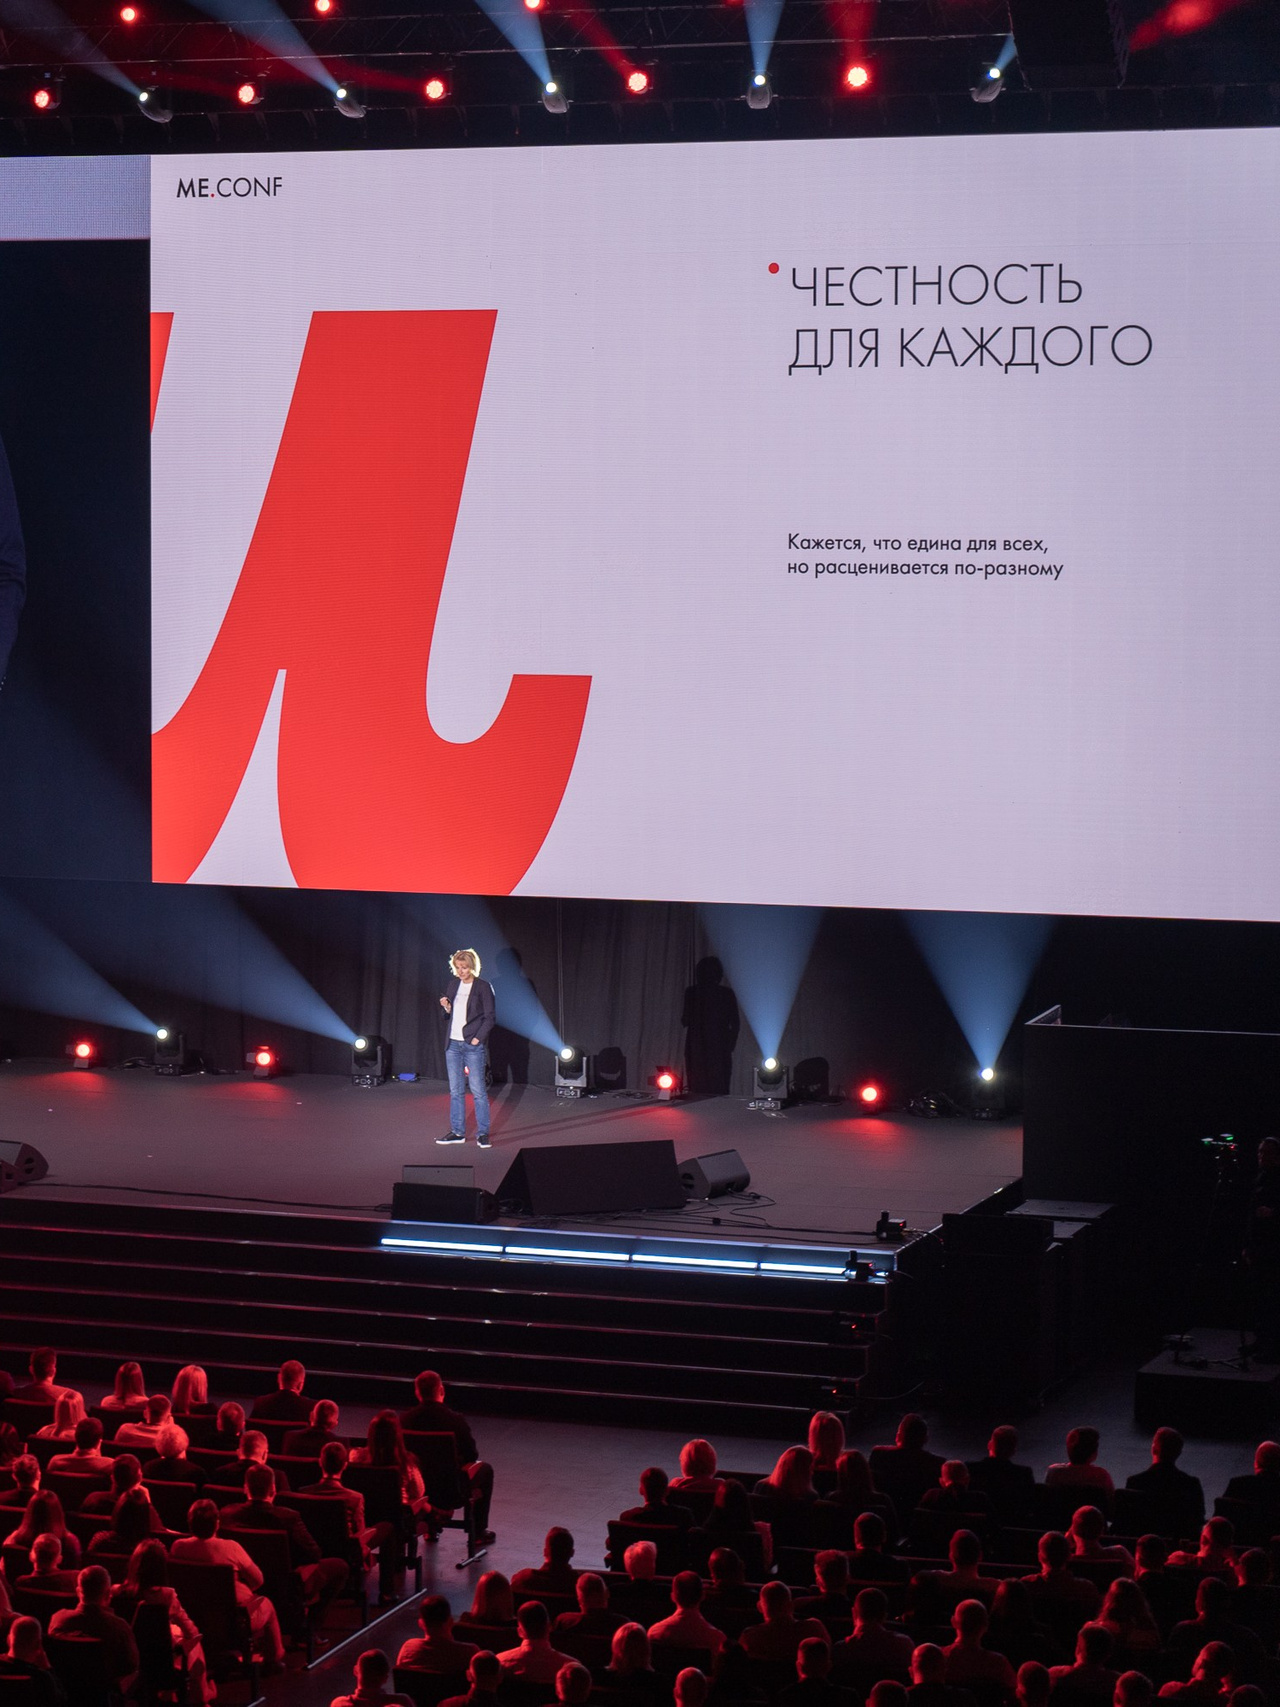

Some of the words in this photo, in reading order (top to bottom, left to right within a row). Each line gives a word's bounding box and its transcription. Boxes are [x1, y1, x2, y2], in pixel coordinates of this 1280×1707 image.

[176, 176, 283, 199] ME.CONF
[790, 262, 1084, 307] ЧЕСТНОСТЬ
[787, 327, 880, 377] ДЛЯ
[898, 323, 1154, 375] КАЖДОГО
[787, 532, 867, 554] Кажется,
[872, 538, 903, 551] что
[906, 538, 962, 553] едина
[966, 538, 998, 554] для
[1002, 538, 1049, 555] всех,
[786, 561, 810, 575] но
[814, 562, 950, 579] расценивается
[954, 563, 1065, 581] по-разному
